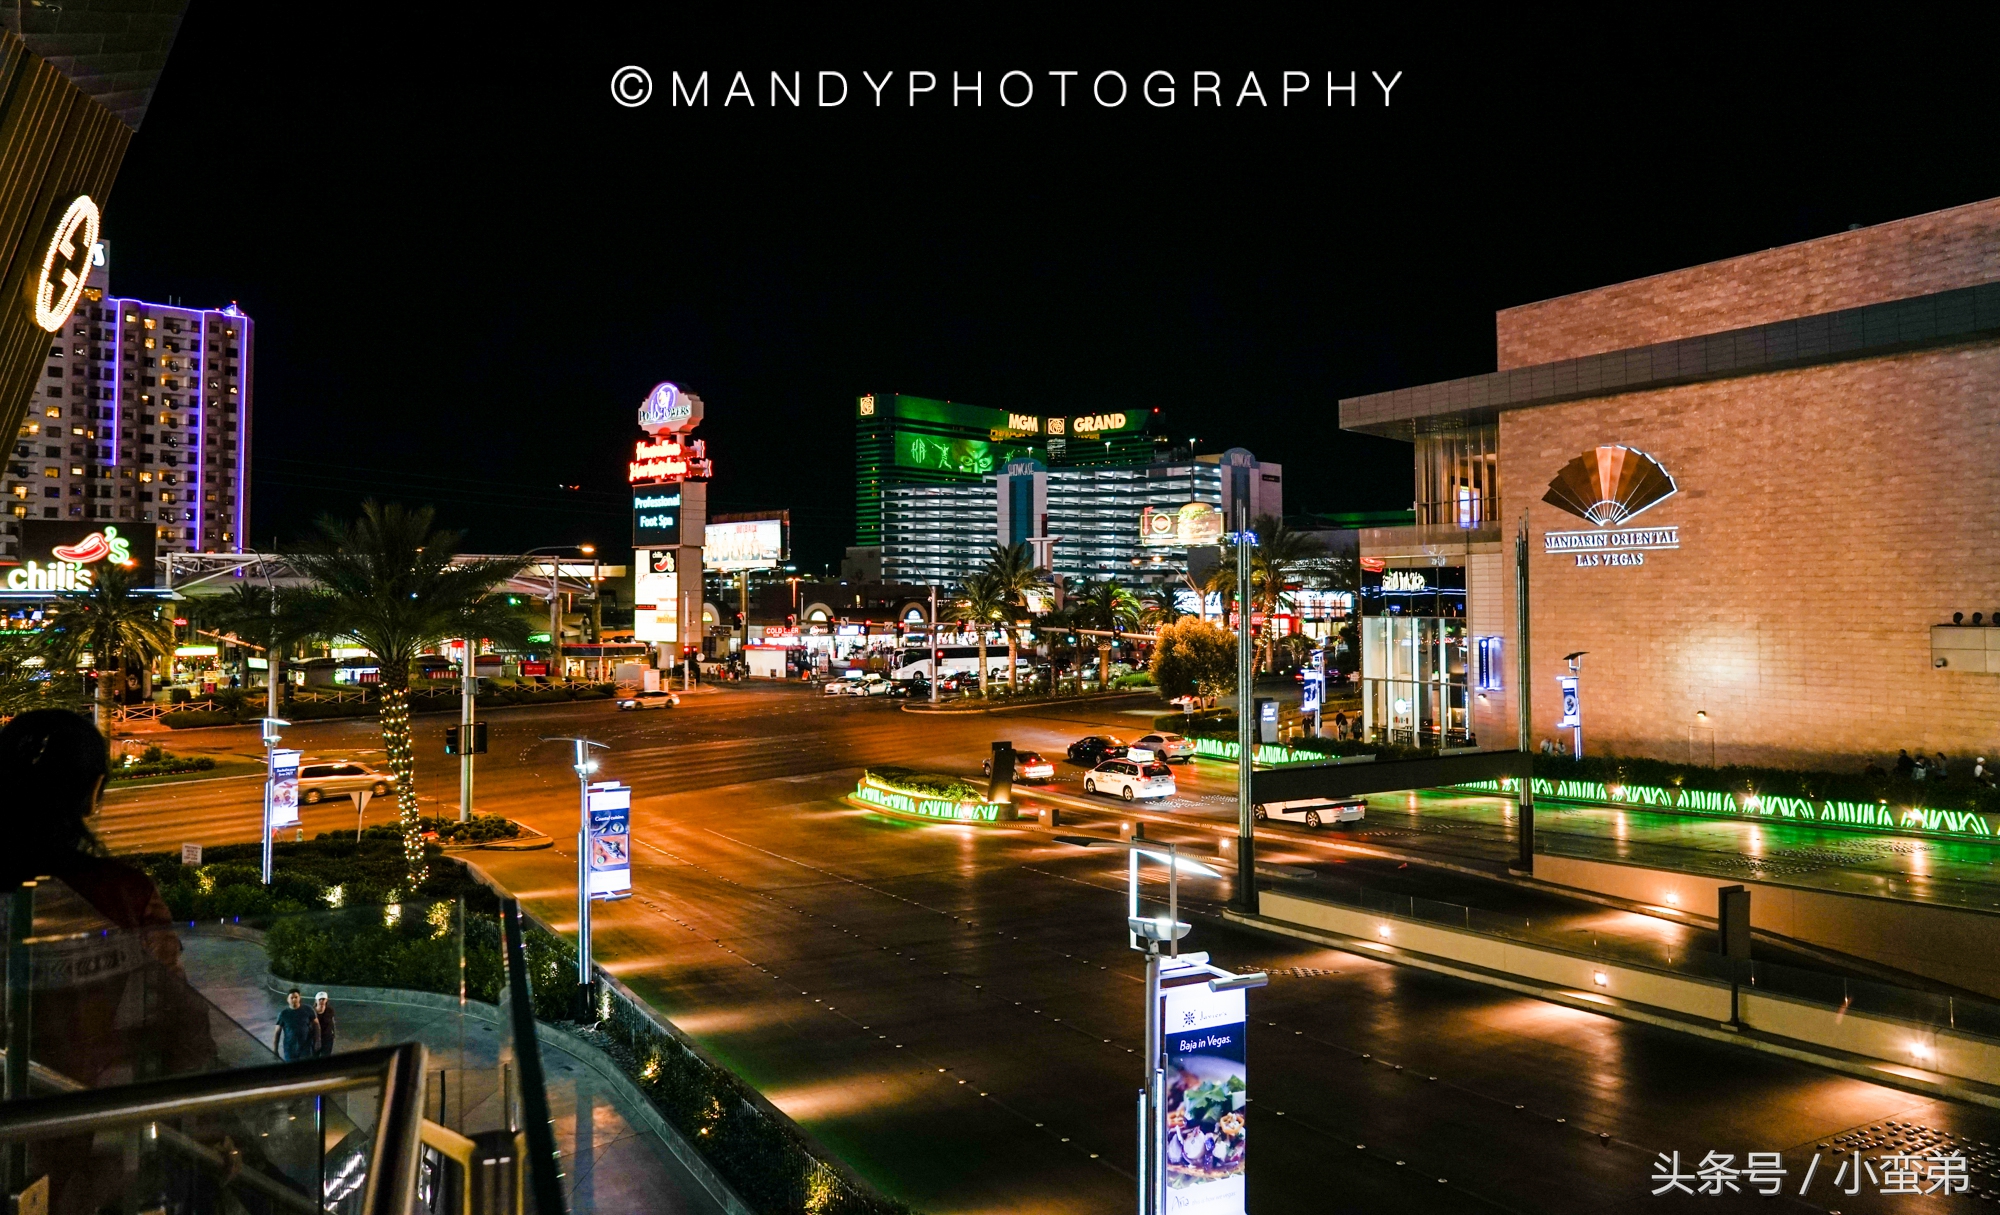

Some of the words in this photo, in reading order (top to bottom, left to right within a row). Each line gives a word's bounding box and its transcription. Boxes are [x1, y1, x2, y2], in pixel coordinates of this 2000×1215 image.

[1008, 413, 1039, 432] MGM
[1073, 413, 1126, 432] GRAND
[1008, 462, 1035, 477] SHOWCASE
[635, 494, 680, 509] Professional
[640, 515, 658, 528] Foot
[658, 514, 674, 528] Spa
[1544, 534, 1608, 549] MANDARIN
[1611, 531, 1680, 546] ORIENTAL
[1576, 554, 1599, 567] LAS
[1602, 553, 1644, 566] VEGAS
[1179, 1039, 1198, 1053] Baja
[1198, 1038, 1206, 1048] in
[1206, 1034, 1232, 1048] Vegas.
